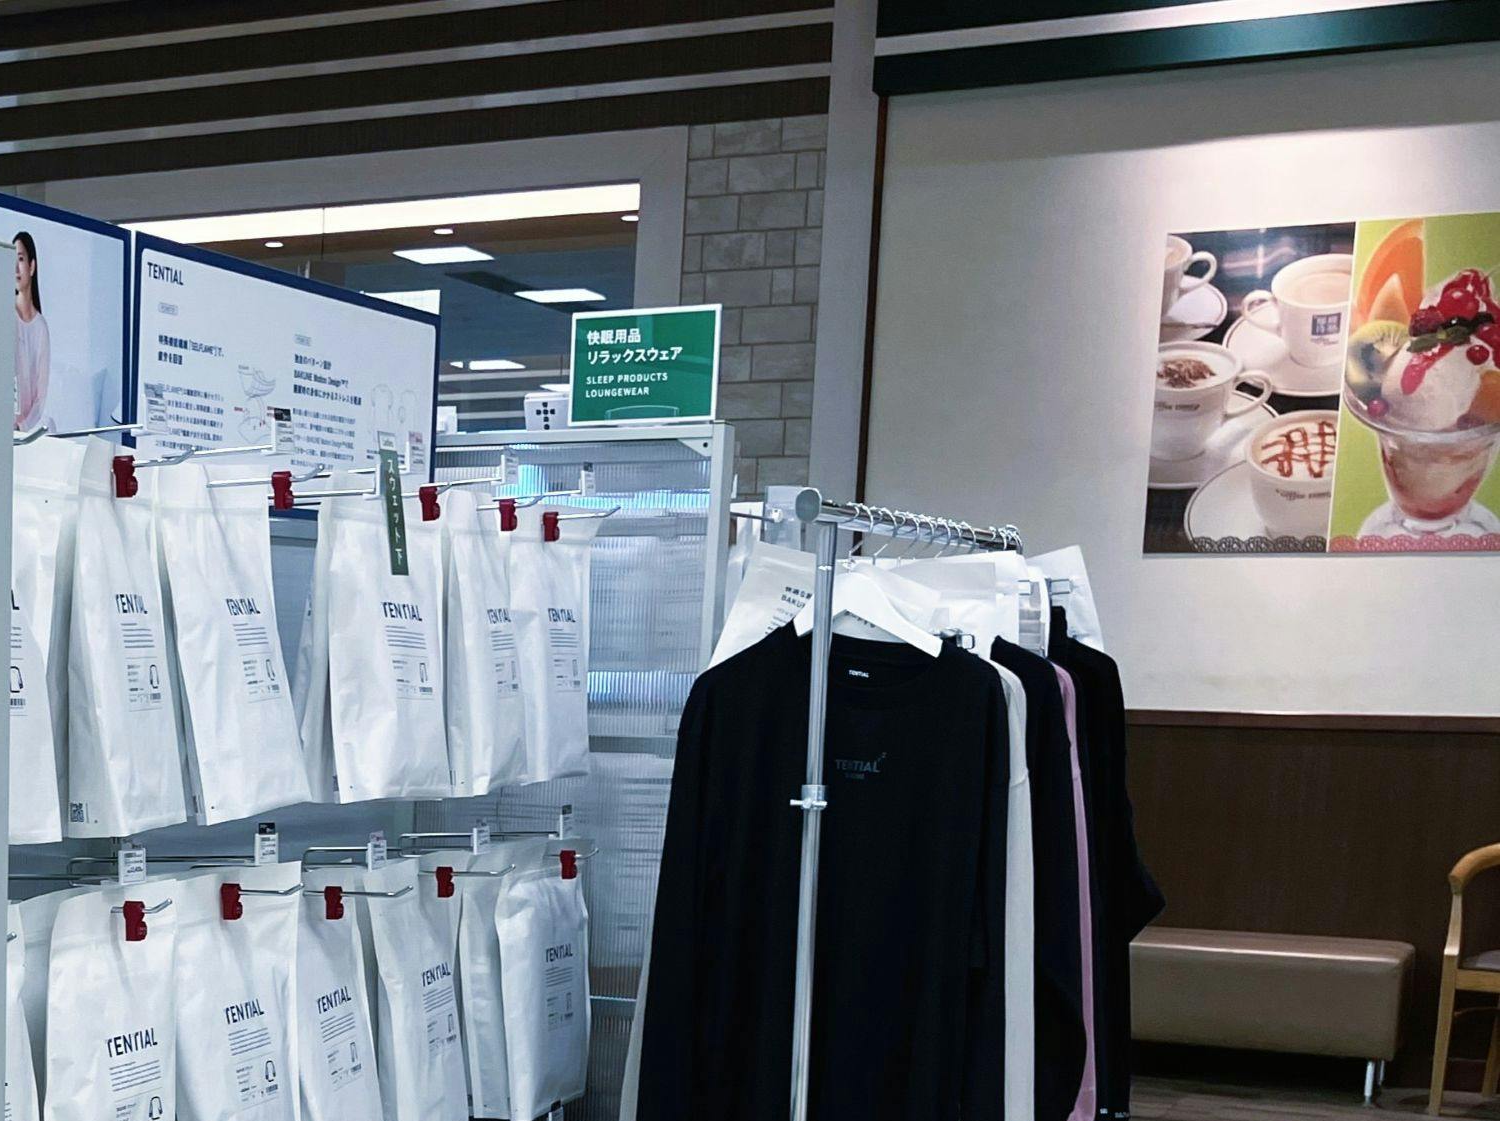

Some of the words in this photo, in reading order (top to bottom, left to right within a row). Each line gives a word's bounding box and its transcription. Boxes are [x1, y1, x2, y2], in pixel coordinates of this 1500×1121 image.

[147, 261, 184, 286] TENTIAL
[586, 327, 642, 346] 快眠用品
[587, 346, 684, 366] リラックスウェア
[586, 375, 615, 386] SLEEP
[617, 372, 668, 384] PRODUCTS
[585, 386, 650, 399] LOUNGEWEAR
[387, 459, 403, 565] スウェット下
[226, 598, 261, 617] TENTIAL
[382, 602, 422, 622] TENTIAL
[547, 607, 577, 624] TENTIAL
[545, 943, 573, 963] TENTIAL
[422, 962, 452, 987] TENTIAL
[317, 986, 351, 1014] TENTIAL
[224, 998, 265, 1025] TENTIAL
[106, 1027, 158, 1058] TENTIAL
